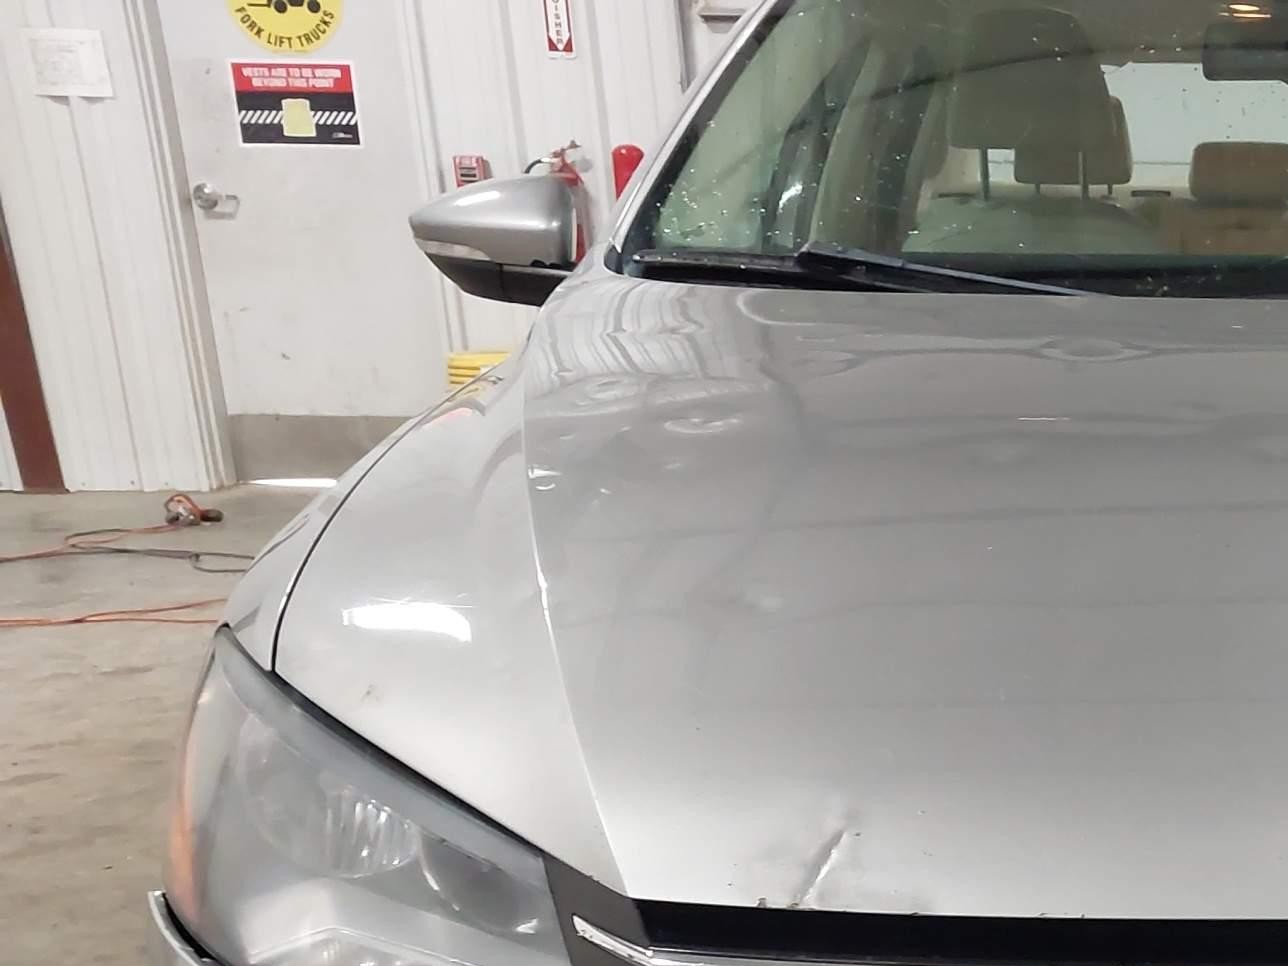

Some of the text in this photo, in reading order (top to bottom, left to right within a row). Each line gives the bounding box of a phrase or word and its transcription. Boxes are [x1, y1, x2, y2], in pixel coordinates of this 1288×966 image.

[235, 6, 335, 49] FORK LIFT TRUCKS
